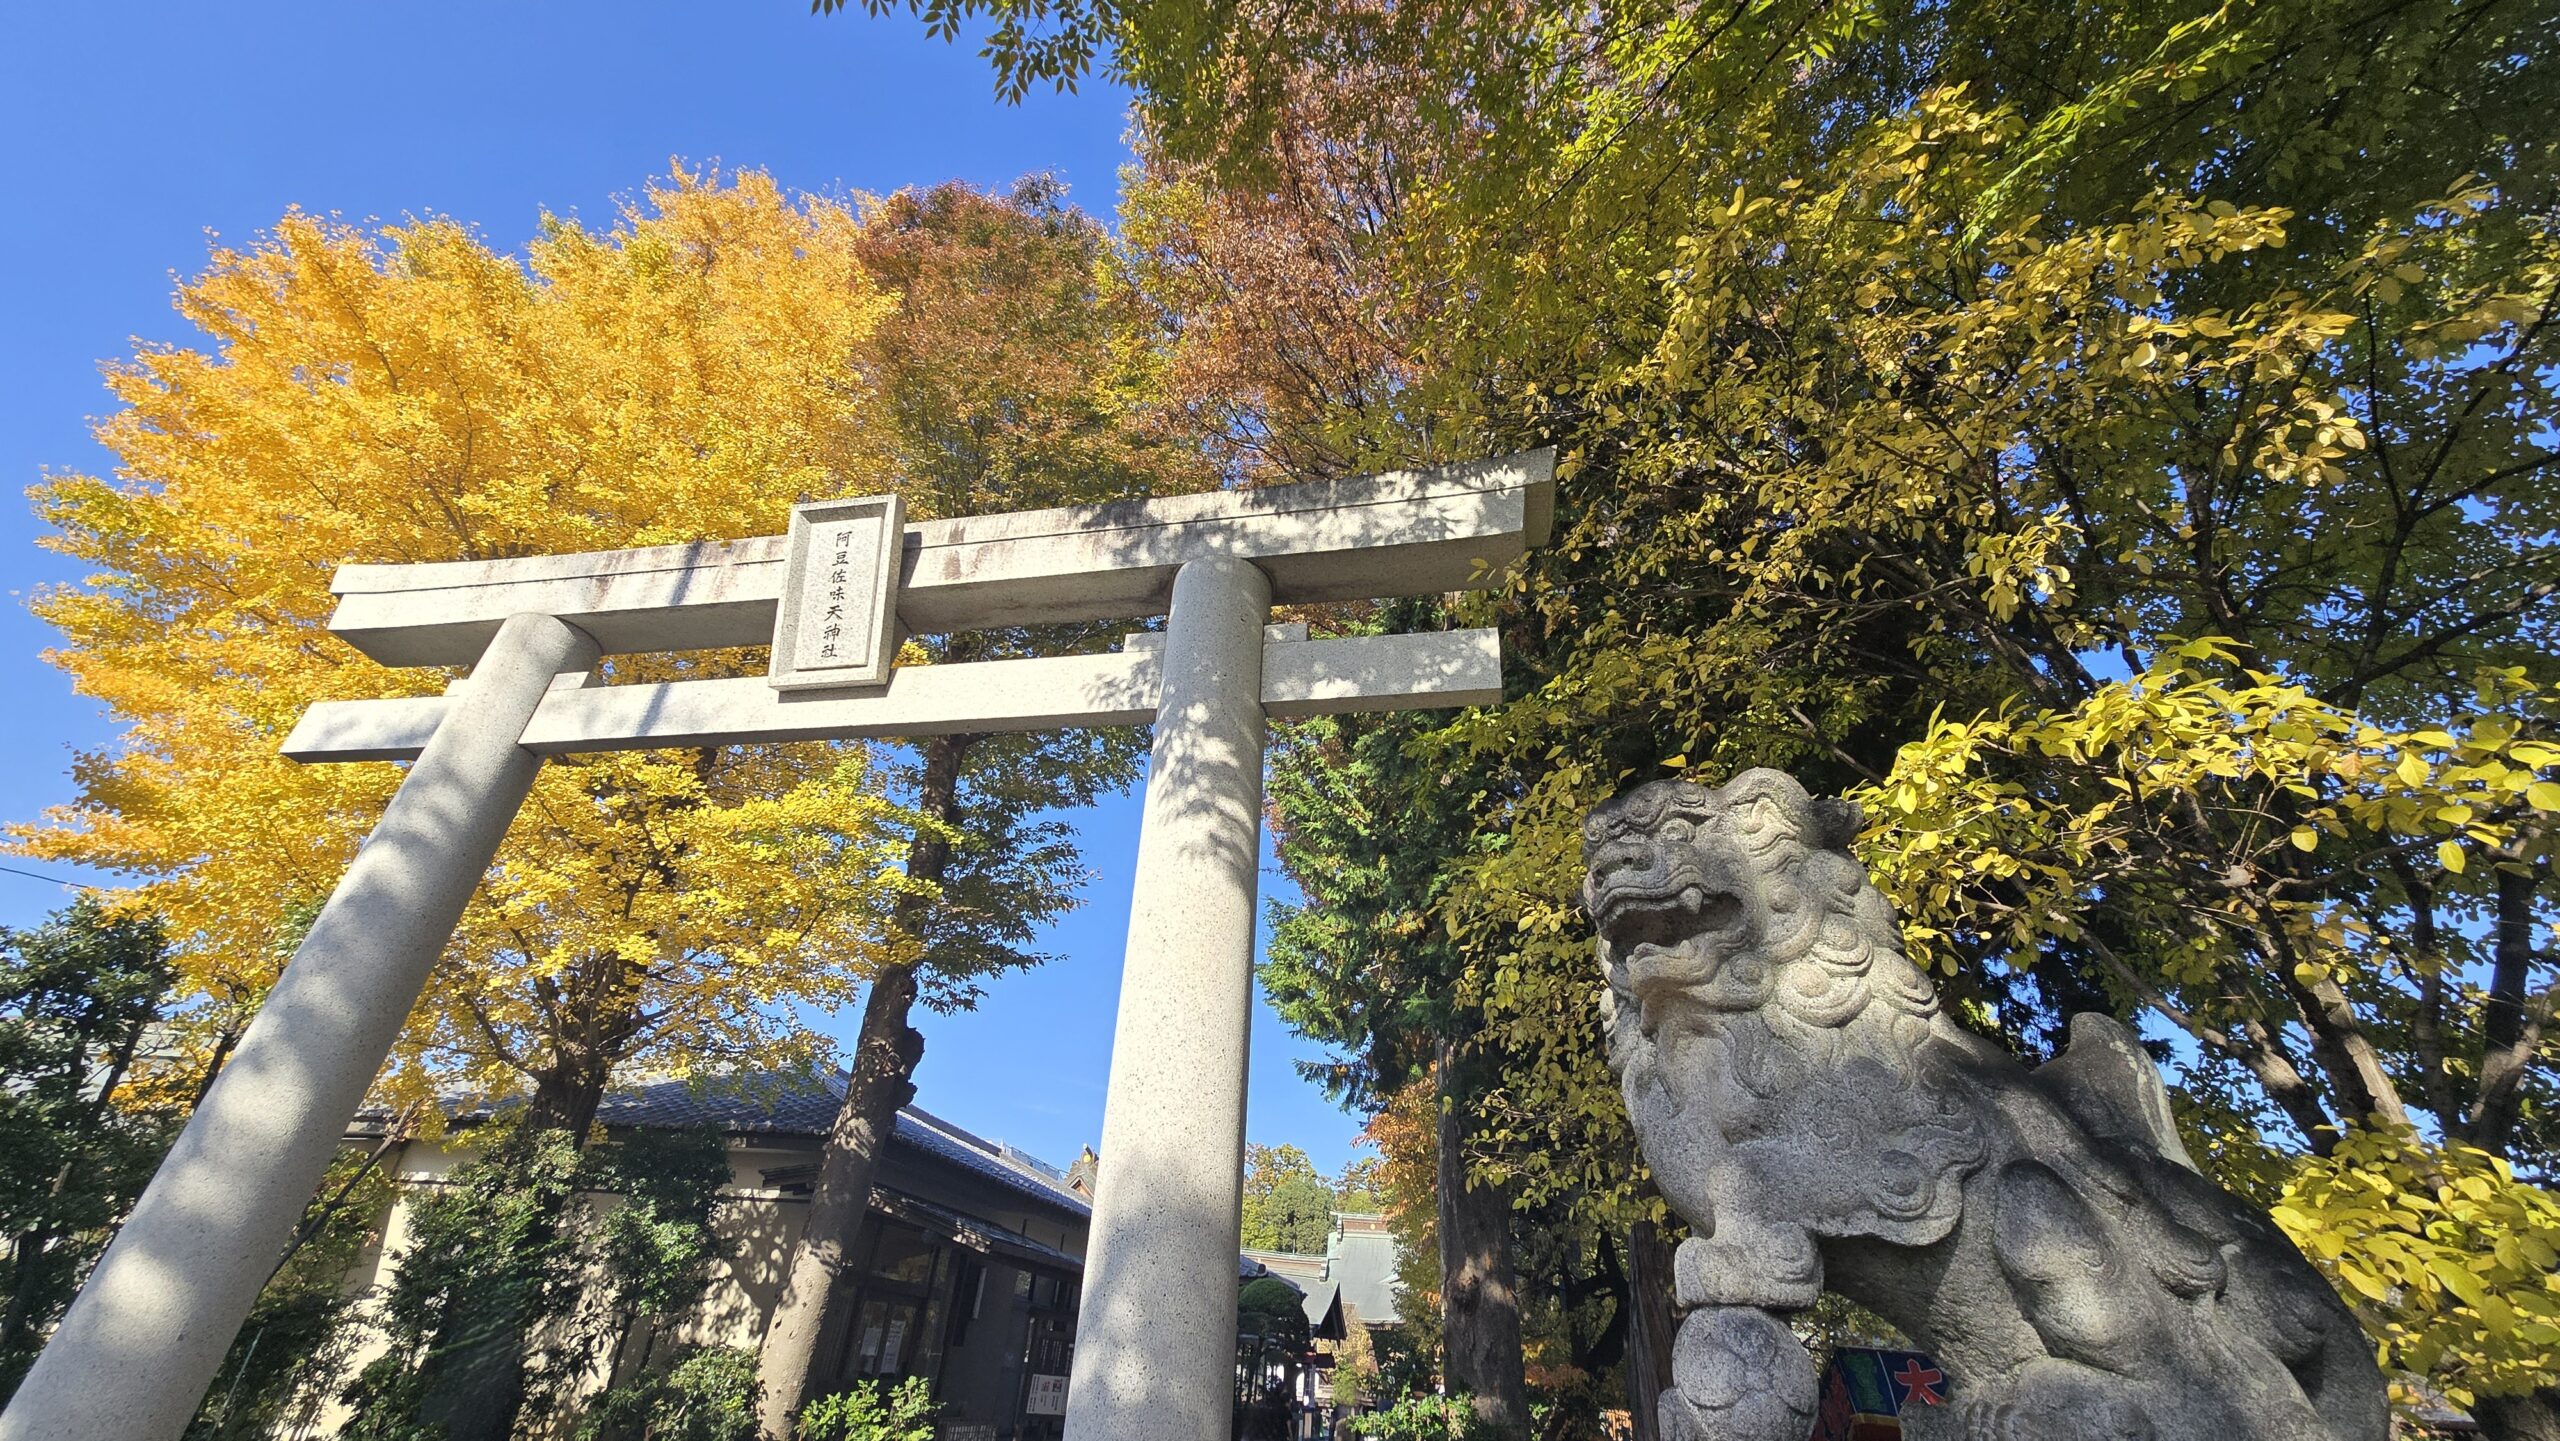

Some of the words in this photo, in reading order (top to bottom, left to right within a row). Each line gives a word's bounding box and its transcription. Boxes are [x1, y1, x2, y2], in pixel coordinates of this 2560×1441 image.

[821, 531, 852, 658] 阿豆佐味天神社
